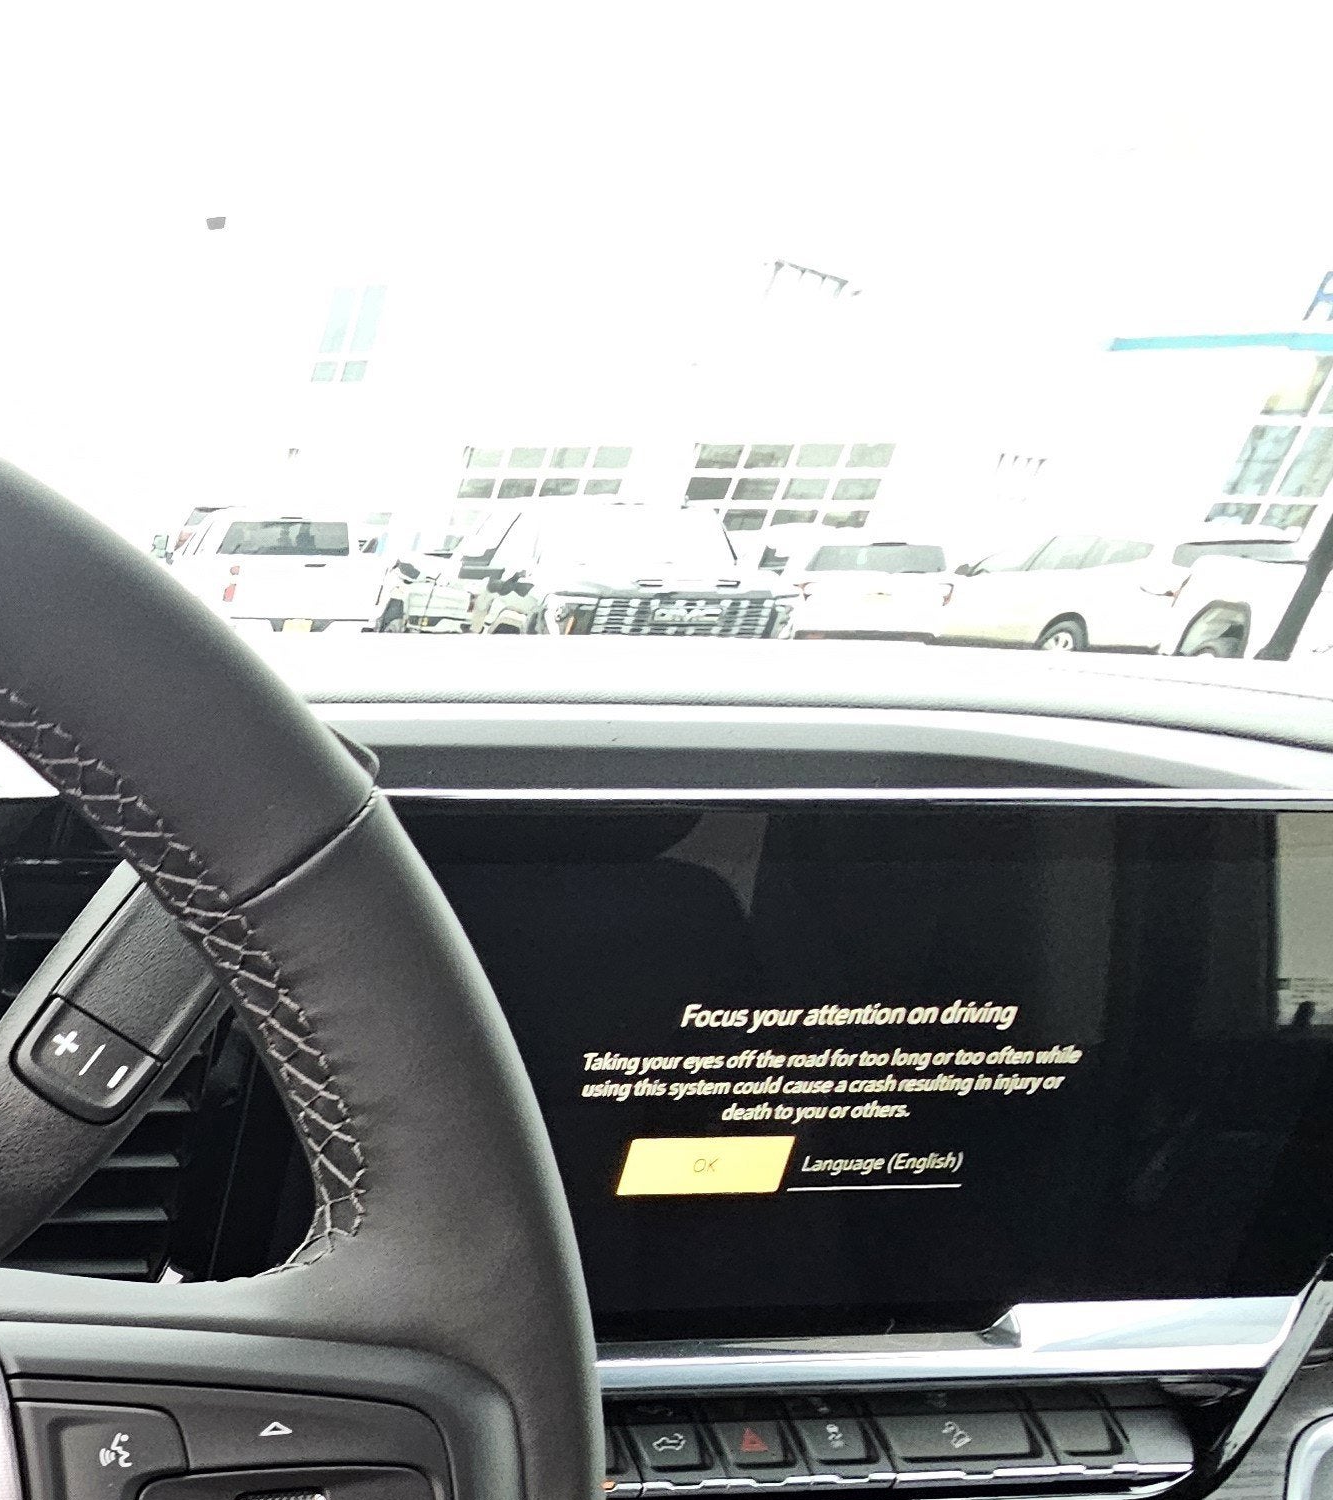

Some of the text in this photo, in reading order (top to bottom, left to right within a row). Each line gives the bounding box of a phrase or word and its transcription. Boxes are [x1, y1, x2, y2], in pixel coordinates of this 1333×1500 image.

[680, 1000, 1018, 1033] Focus your attention on driving
[583, 1045, 1083, 1075] Taking your eyes off the road for too long or too often while
[581, 1074, 1066, 1102] using this system could cause a crash resulting in injury or
[722, 1101, 911, 1124] death to you or others.
[692, 1157, 719, 1174] OK
[801, 1151, 963, 1177] Language (English)
